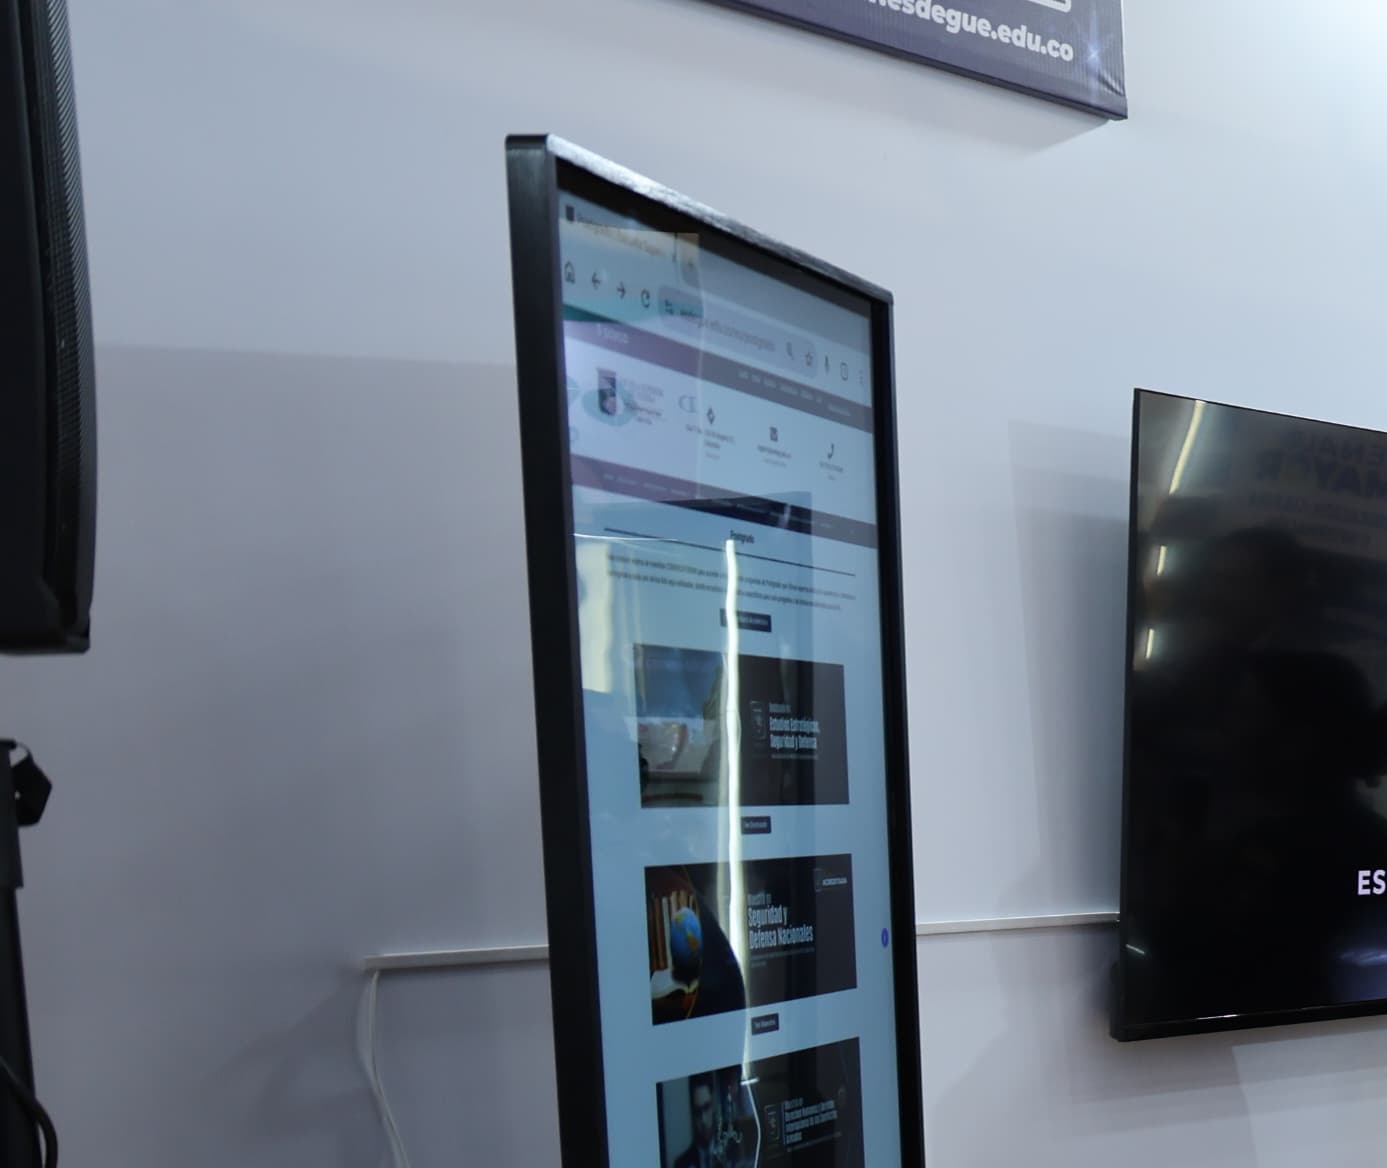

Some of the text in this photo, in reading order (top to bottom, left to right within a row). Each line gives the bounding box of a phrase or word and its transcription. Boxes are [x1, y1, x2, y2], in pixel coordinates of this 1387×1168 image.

[749, 904, 788, 928] Seguridad y
[750, 924, 814, 950] Defensa Nacionales
